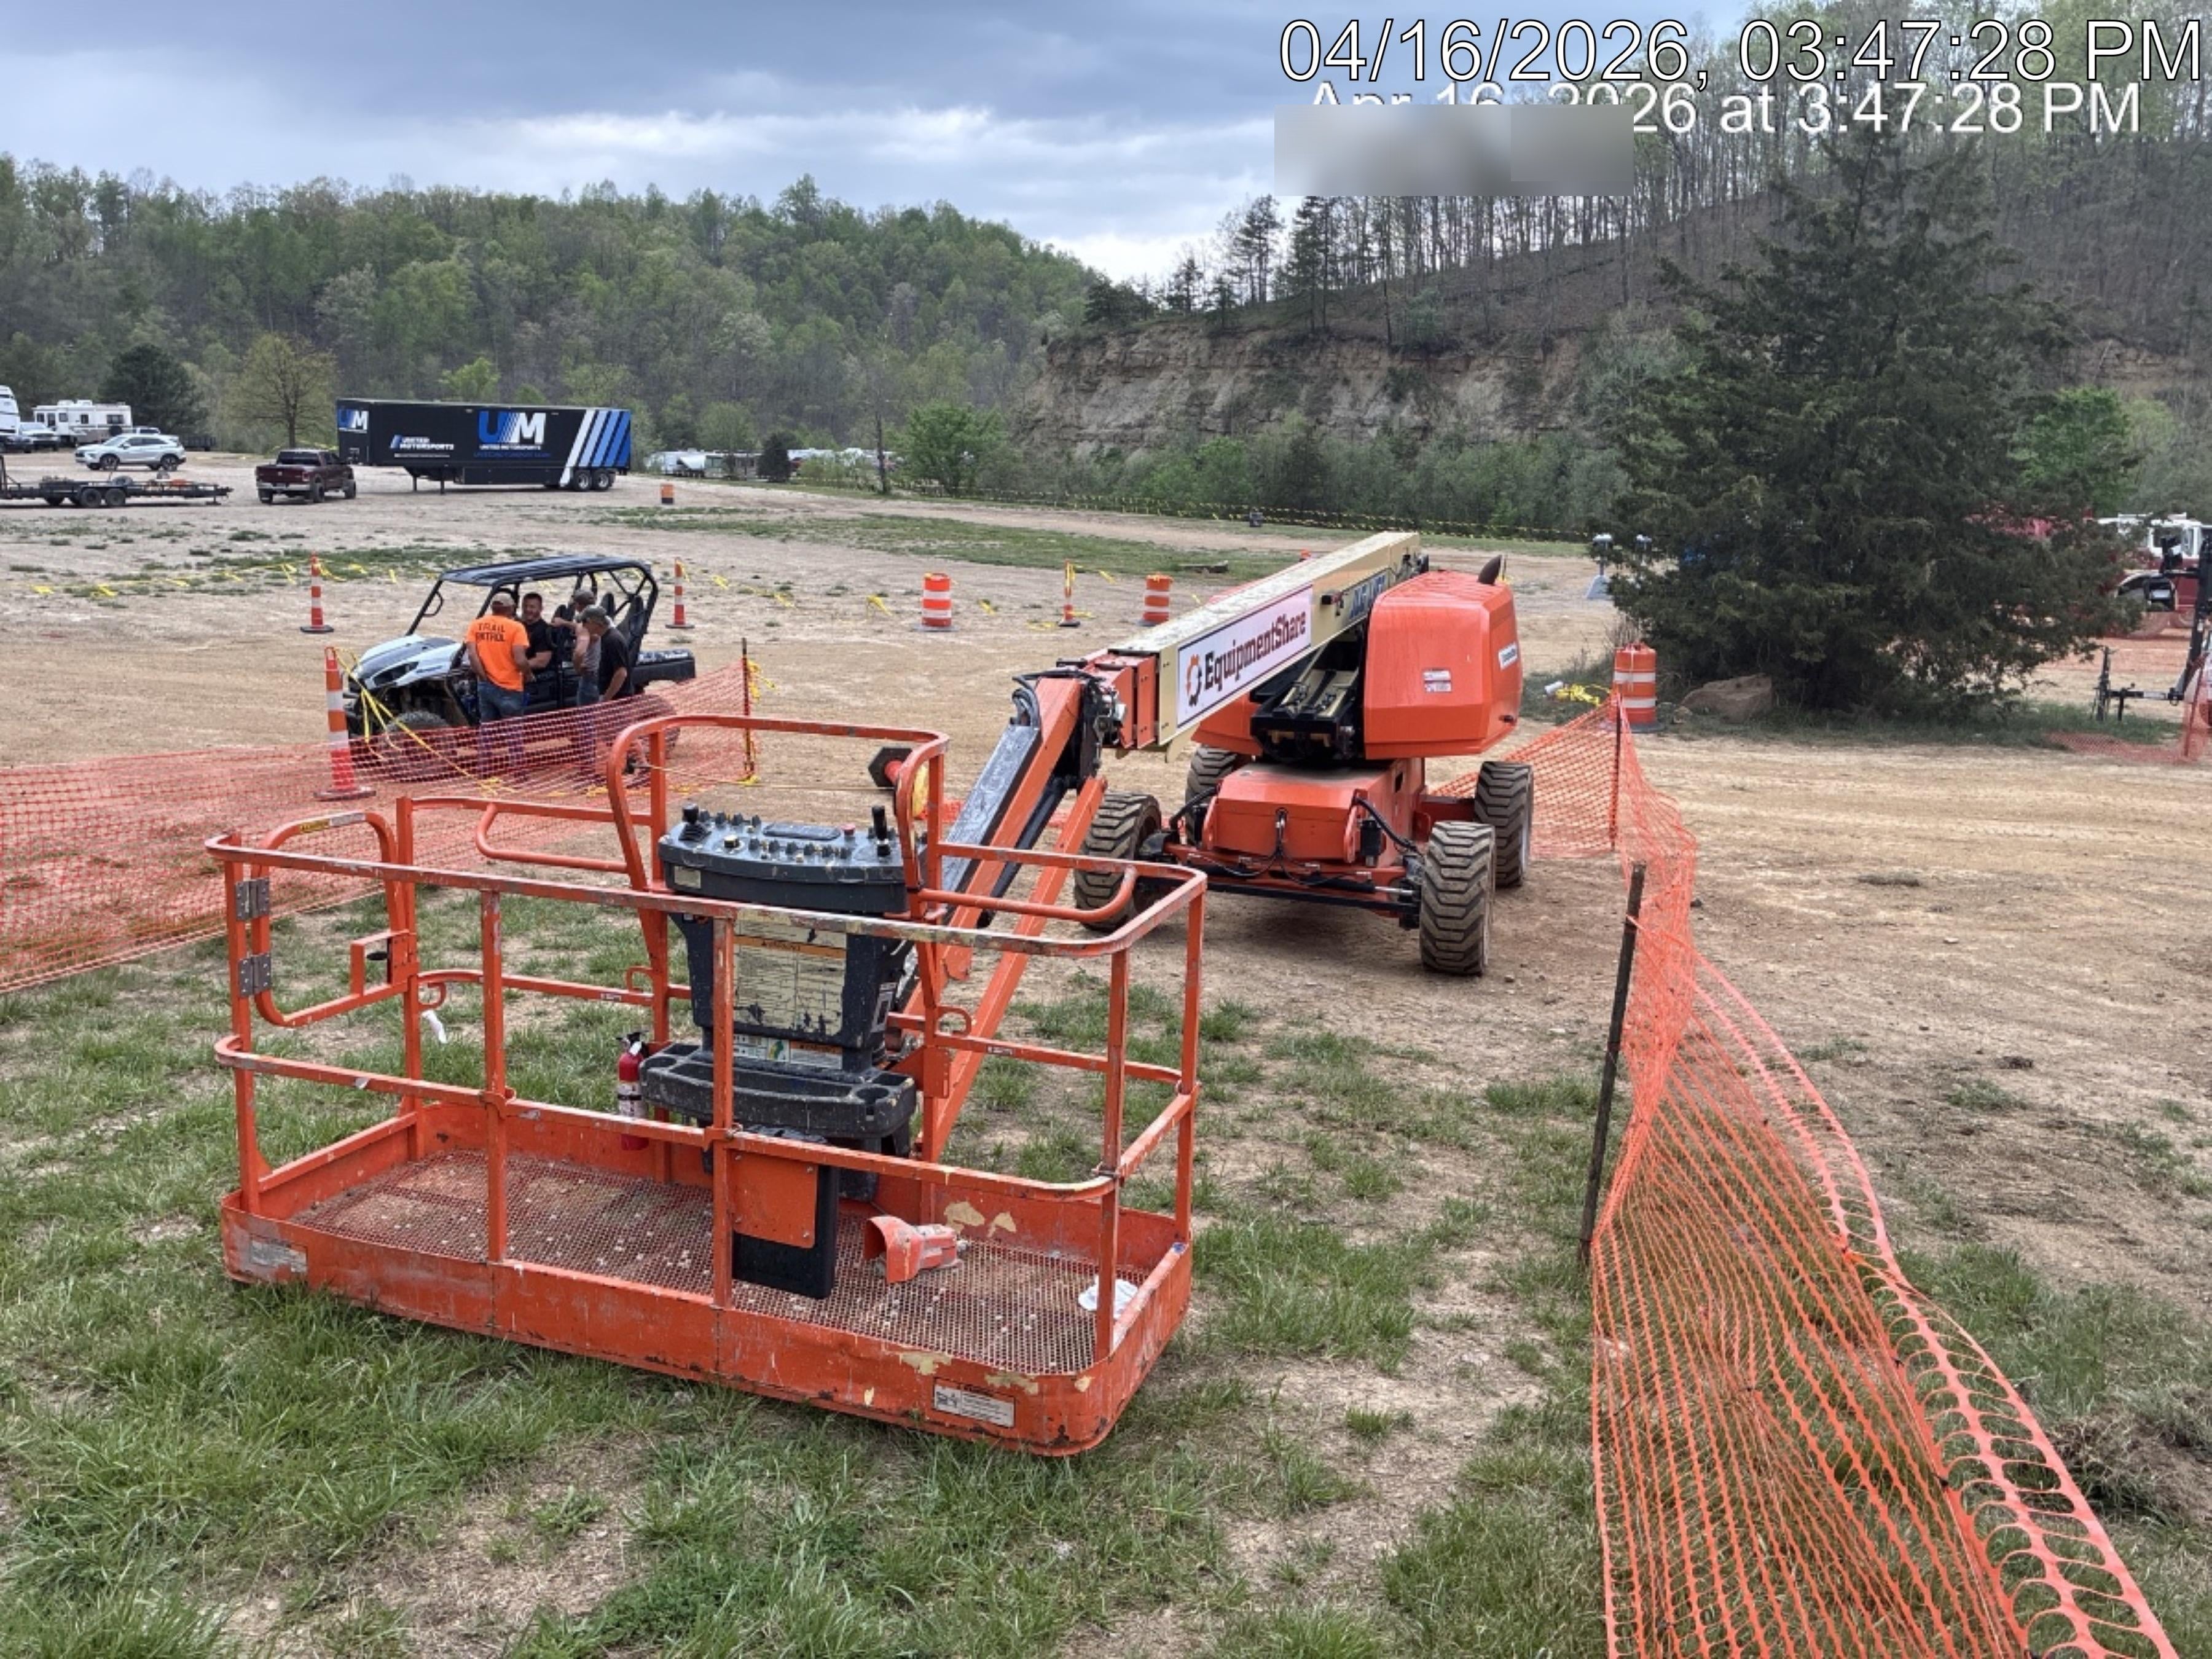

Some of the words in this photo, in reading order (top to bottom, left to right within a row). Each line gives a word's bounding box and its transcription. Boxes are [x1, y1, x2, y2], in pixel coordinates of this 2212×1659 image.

[479, 410, 546, 444] UM
[477, 622, 506, 632] TRAIL
[1204, 611, 1306, 691] EquipmentShare
